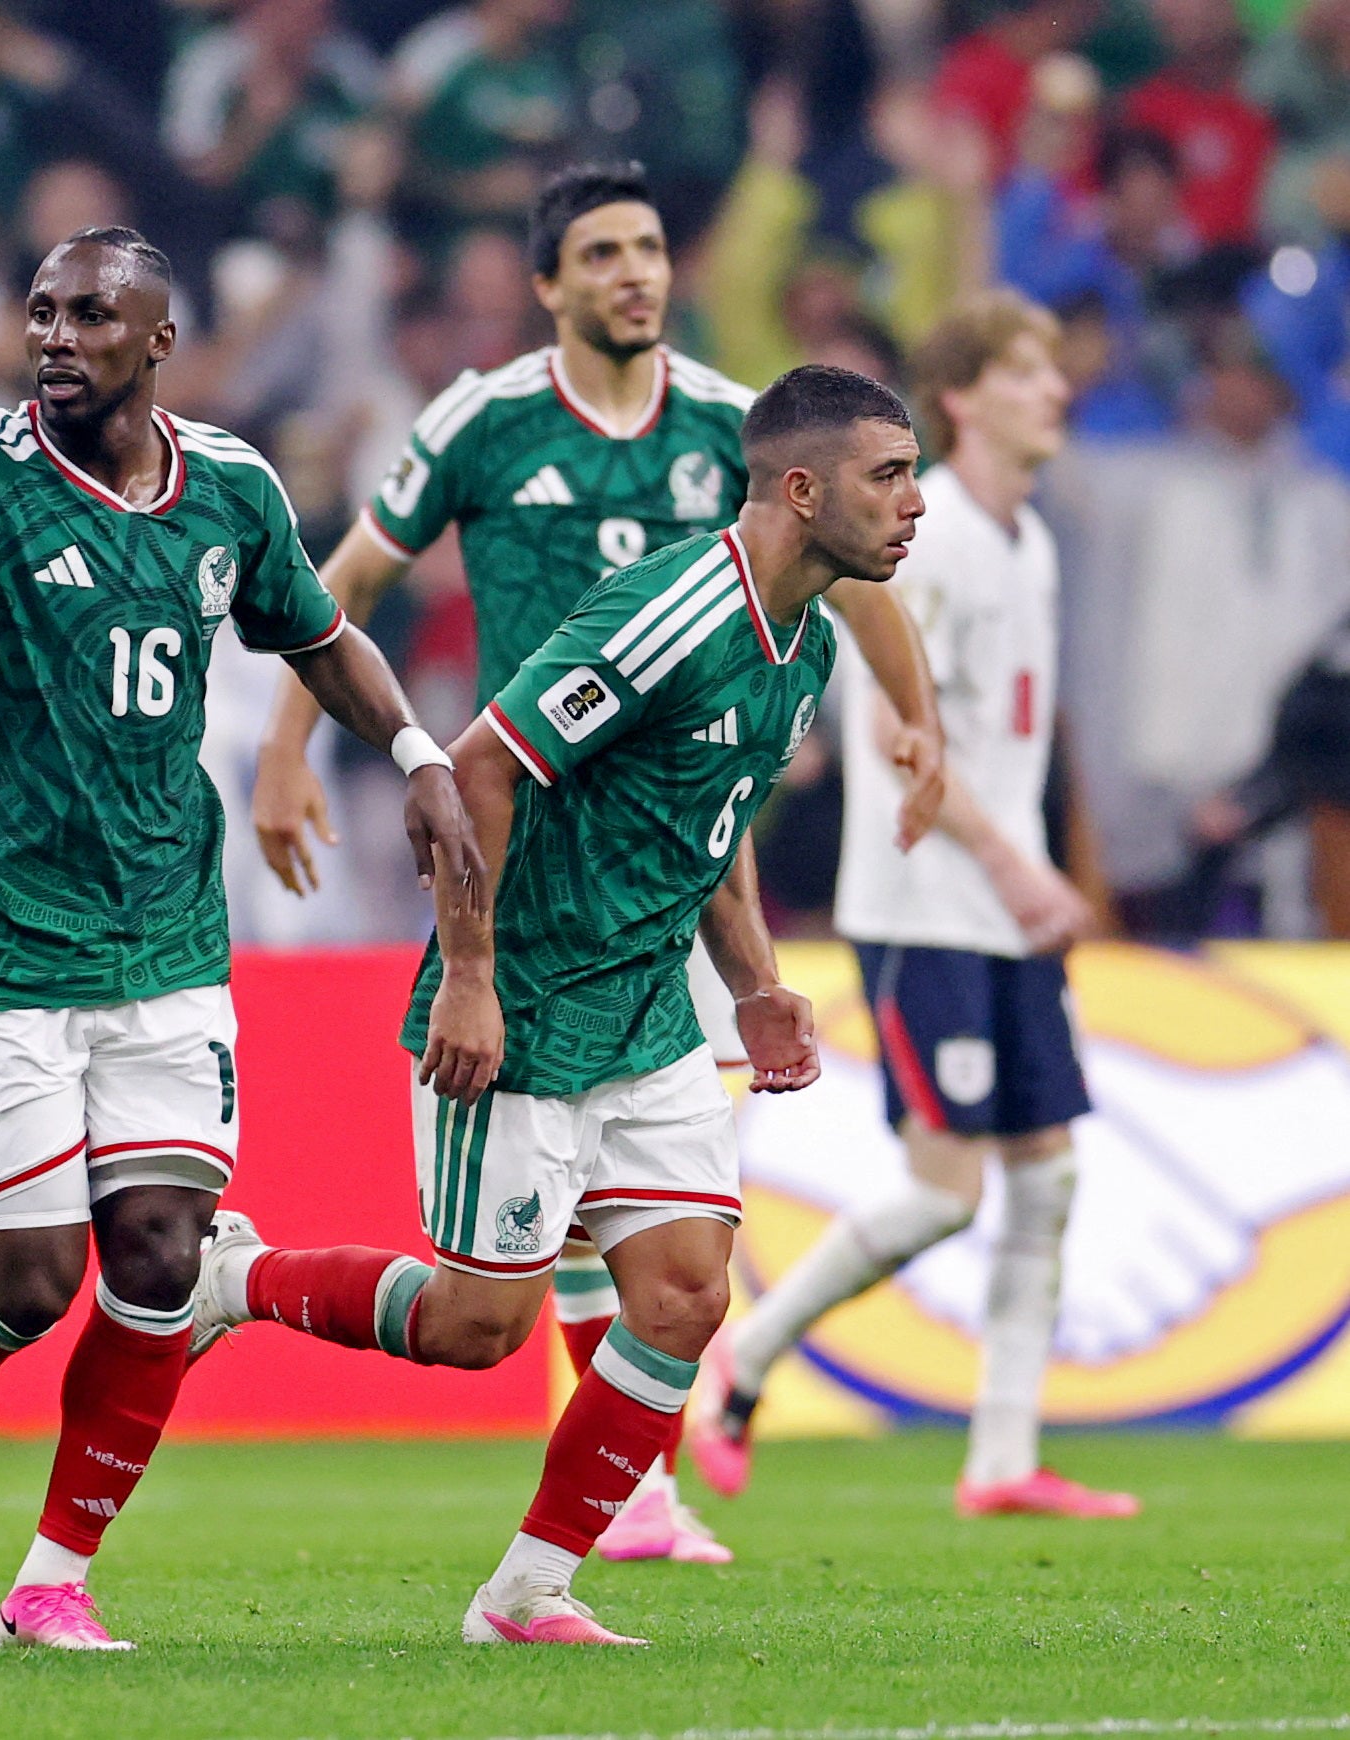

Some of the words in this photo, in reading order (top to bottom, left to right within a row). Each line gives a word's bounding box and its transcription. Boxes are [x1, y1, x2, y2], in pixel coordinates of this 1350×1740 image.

[109, 626, 182, 717] 16
[707, 775, 754, 859] 6
[498, 1240, 538, 1251] MÉXICO
[85, 1445, 147, 1474] MÉXIC
